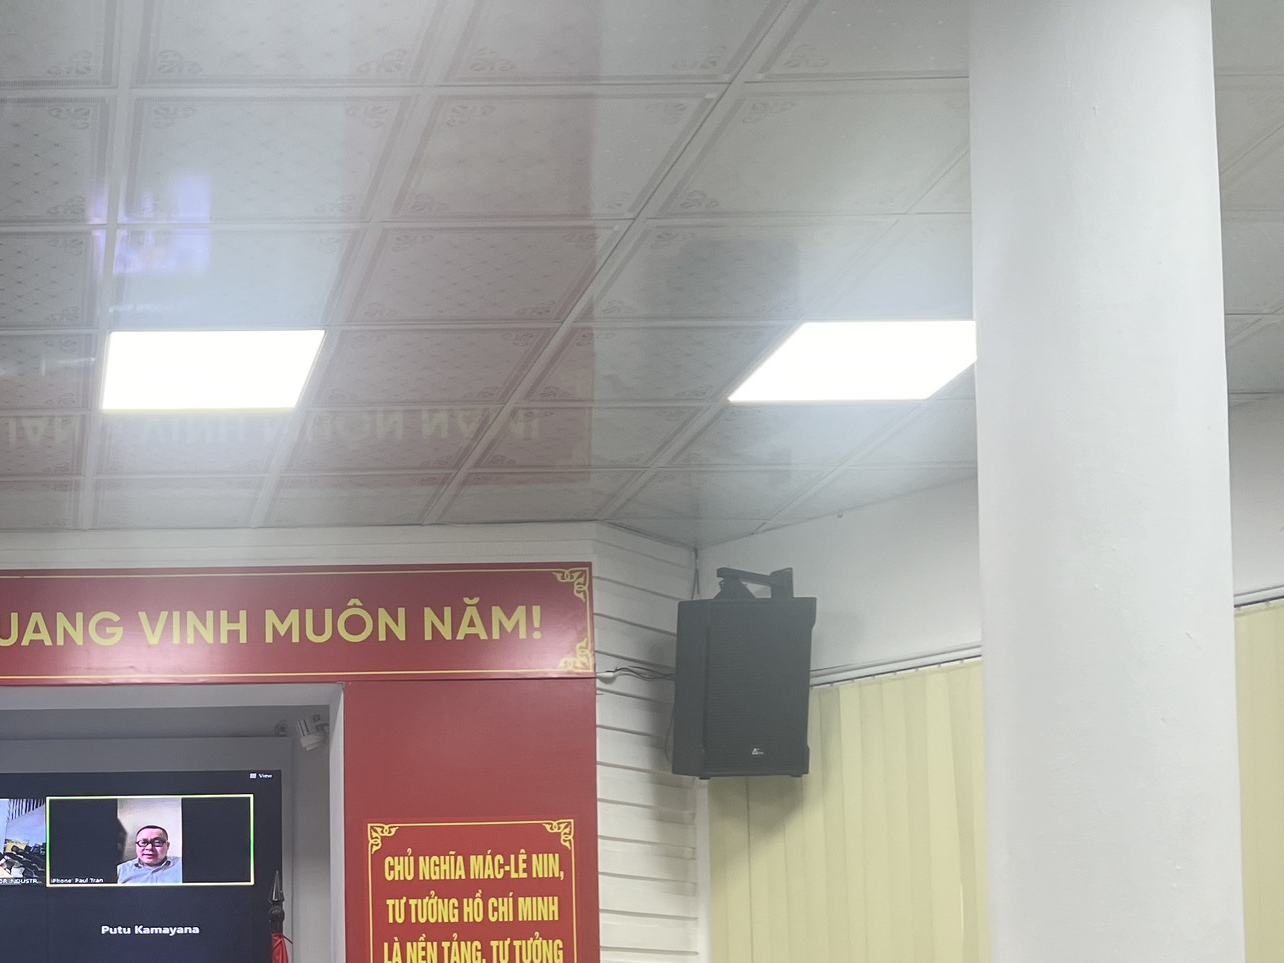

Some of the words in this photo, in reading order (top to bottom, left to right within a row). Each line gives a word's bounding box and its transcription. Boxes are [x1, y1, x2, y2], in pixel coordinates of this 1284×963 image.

[138, 610, 248, 646] VINH
[264, 598, 407, 645] MUÔN
[423, 597, 541, 642] NĂM!
[384, 848, 415, 881] CHỦ
[418, 851, 466, 881] NGHĨA
[469, 849, 528, 880] MÁC-LÊ
[531, 854, 564, 881] NIN,
[386, 897, 407, 924] TƯ
[408, 891, 459, 924] TƯỞNG
[463, 890, 484, 923] HỒ
[487, 892, 514, 923] CHÍ
[517, 897, 559, 922] MINH
[101, 925, 132, 935] Putu
[134, 925, 200, 937] Kamayana
